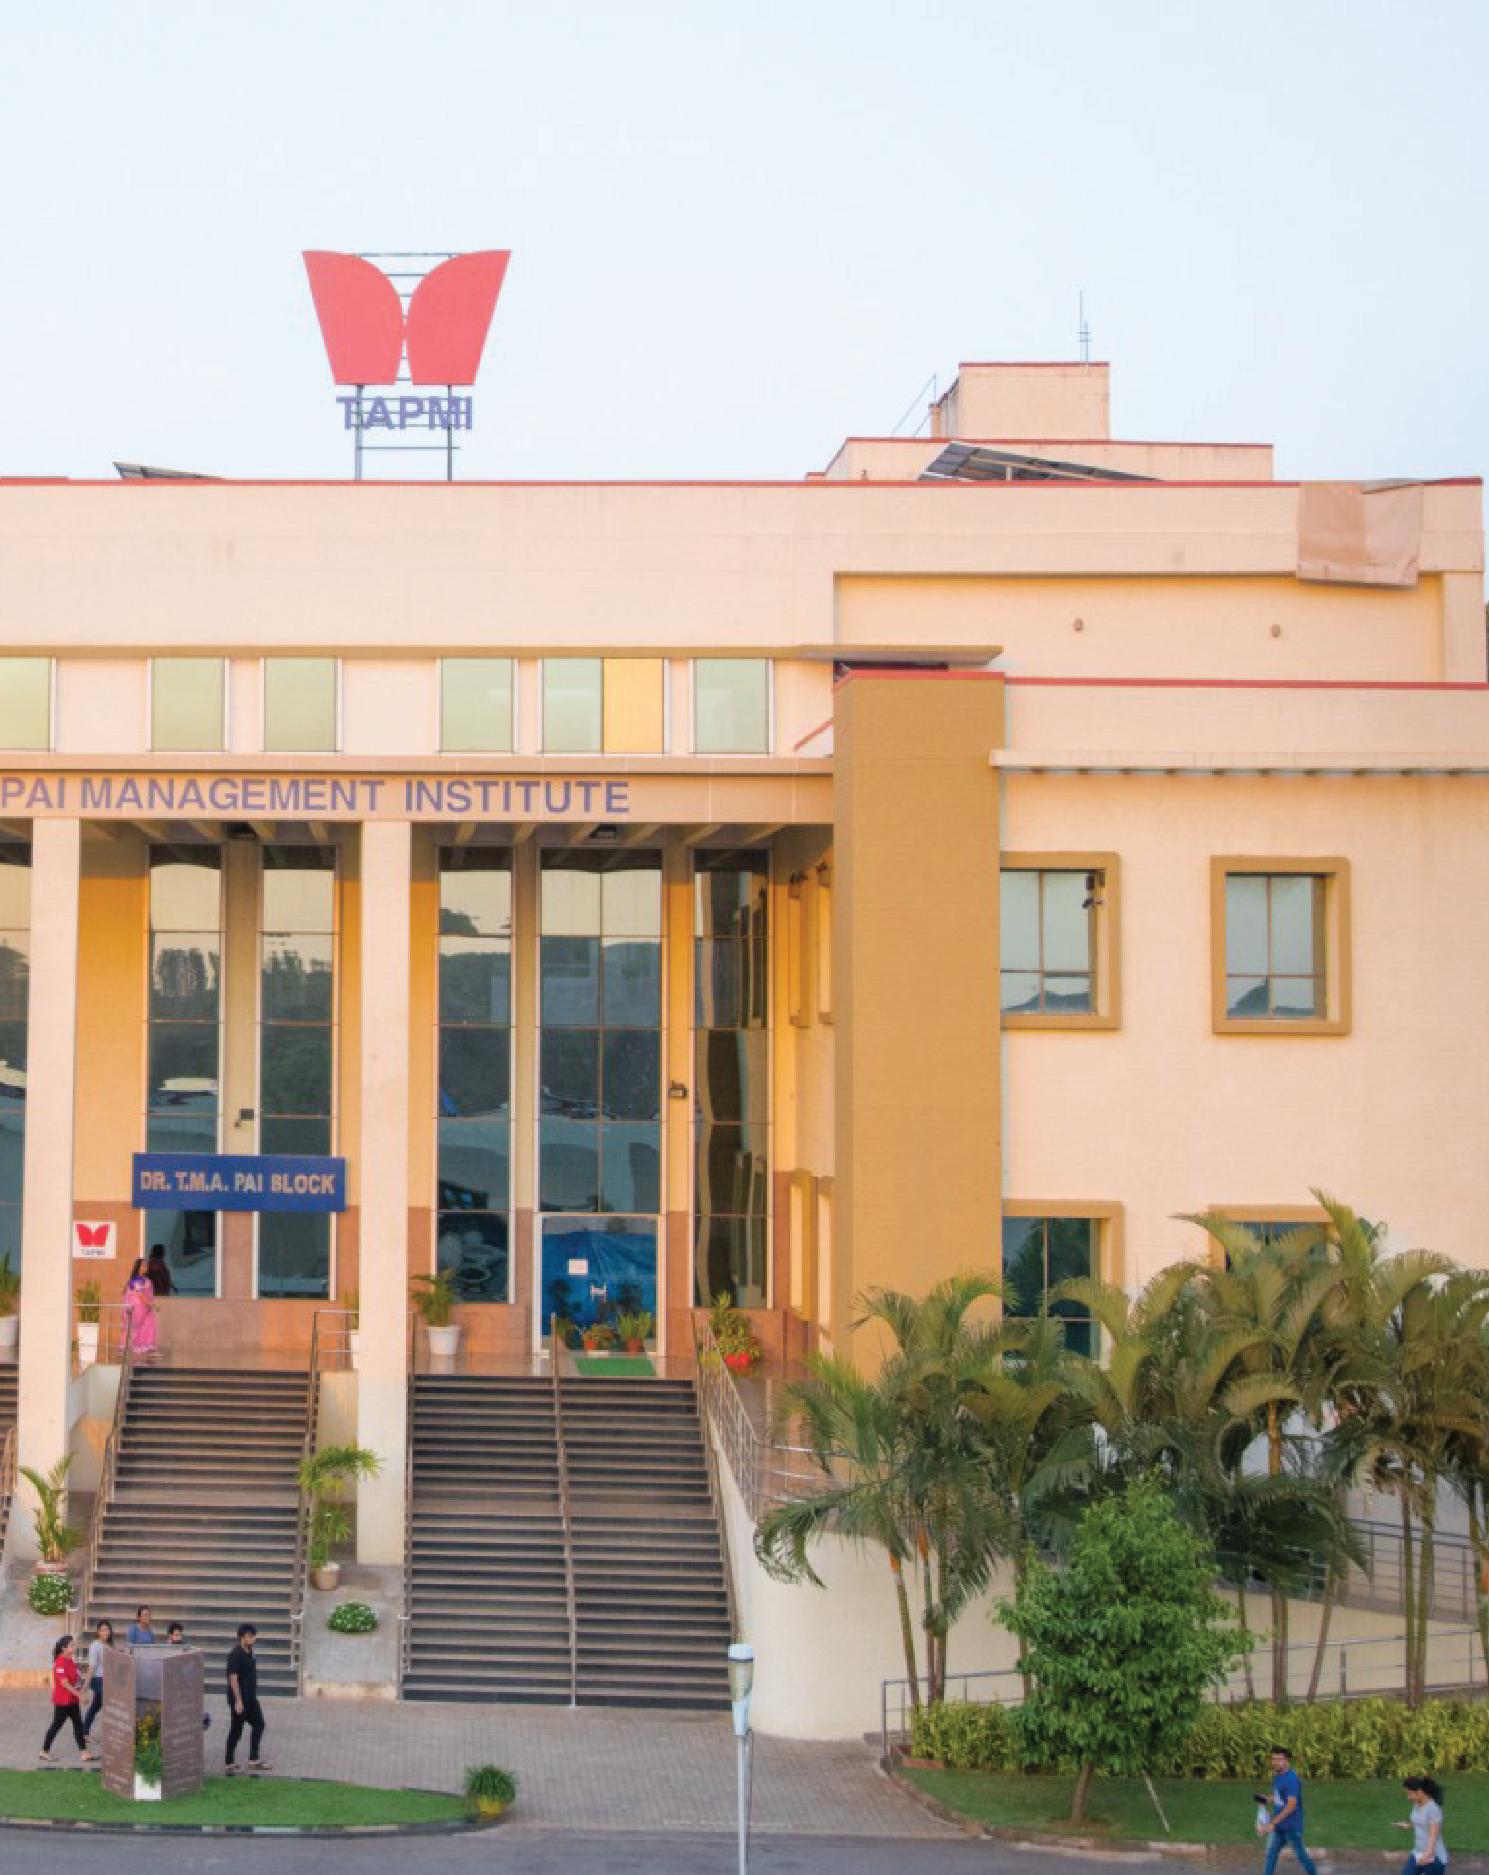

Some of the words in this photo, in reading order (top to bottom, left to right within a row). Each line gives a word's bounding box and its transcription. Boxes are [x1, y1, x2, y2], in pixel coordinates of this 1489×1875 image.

[336, 396, 473, 430] TAPMI
[80, 777, 385, 812] MANAGEMENT
[405, 780, 630, 813] INSTITUTE
[140, 1171, 171, 1191] DR.
[234, 1172, 263, 1192] PAI
[271, 1173, 336, 1195] BLOCK
